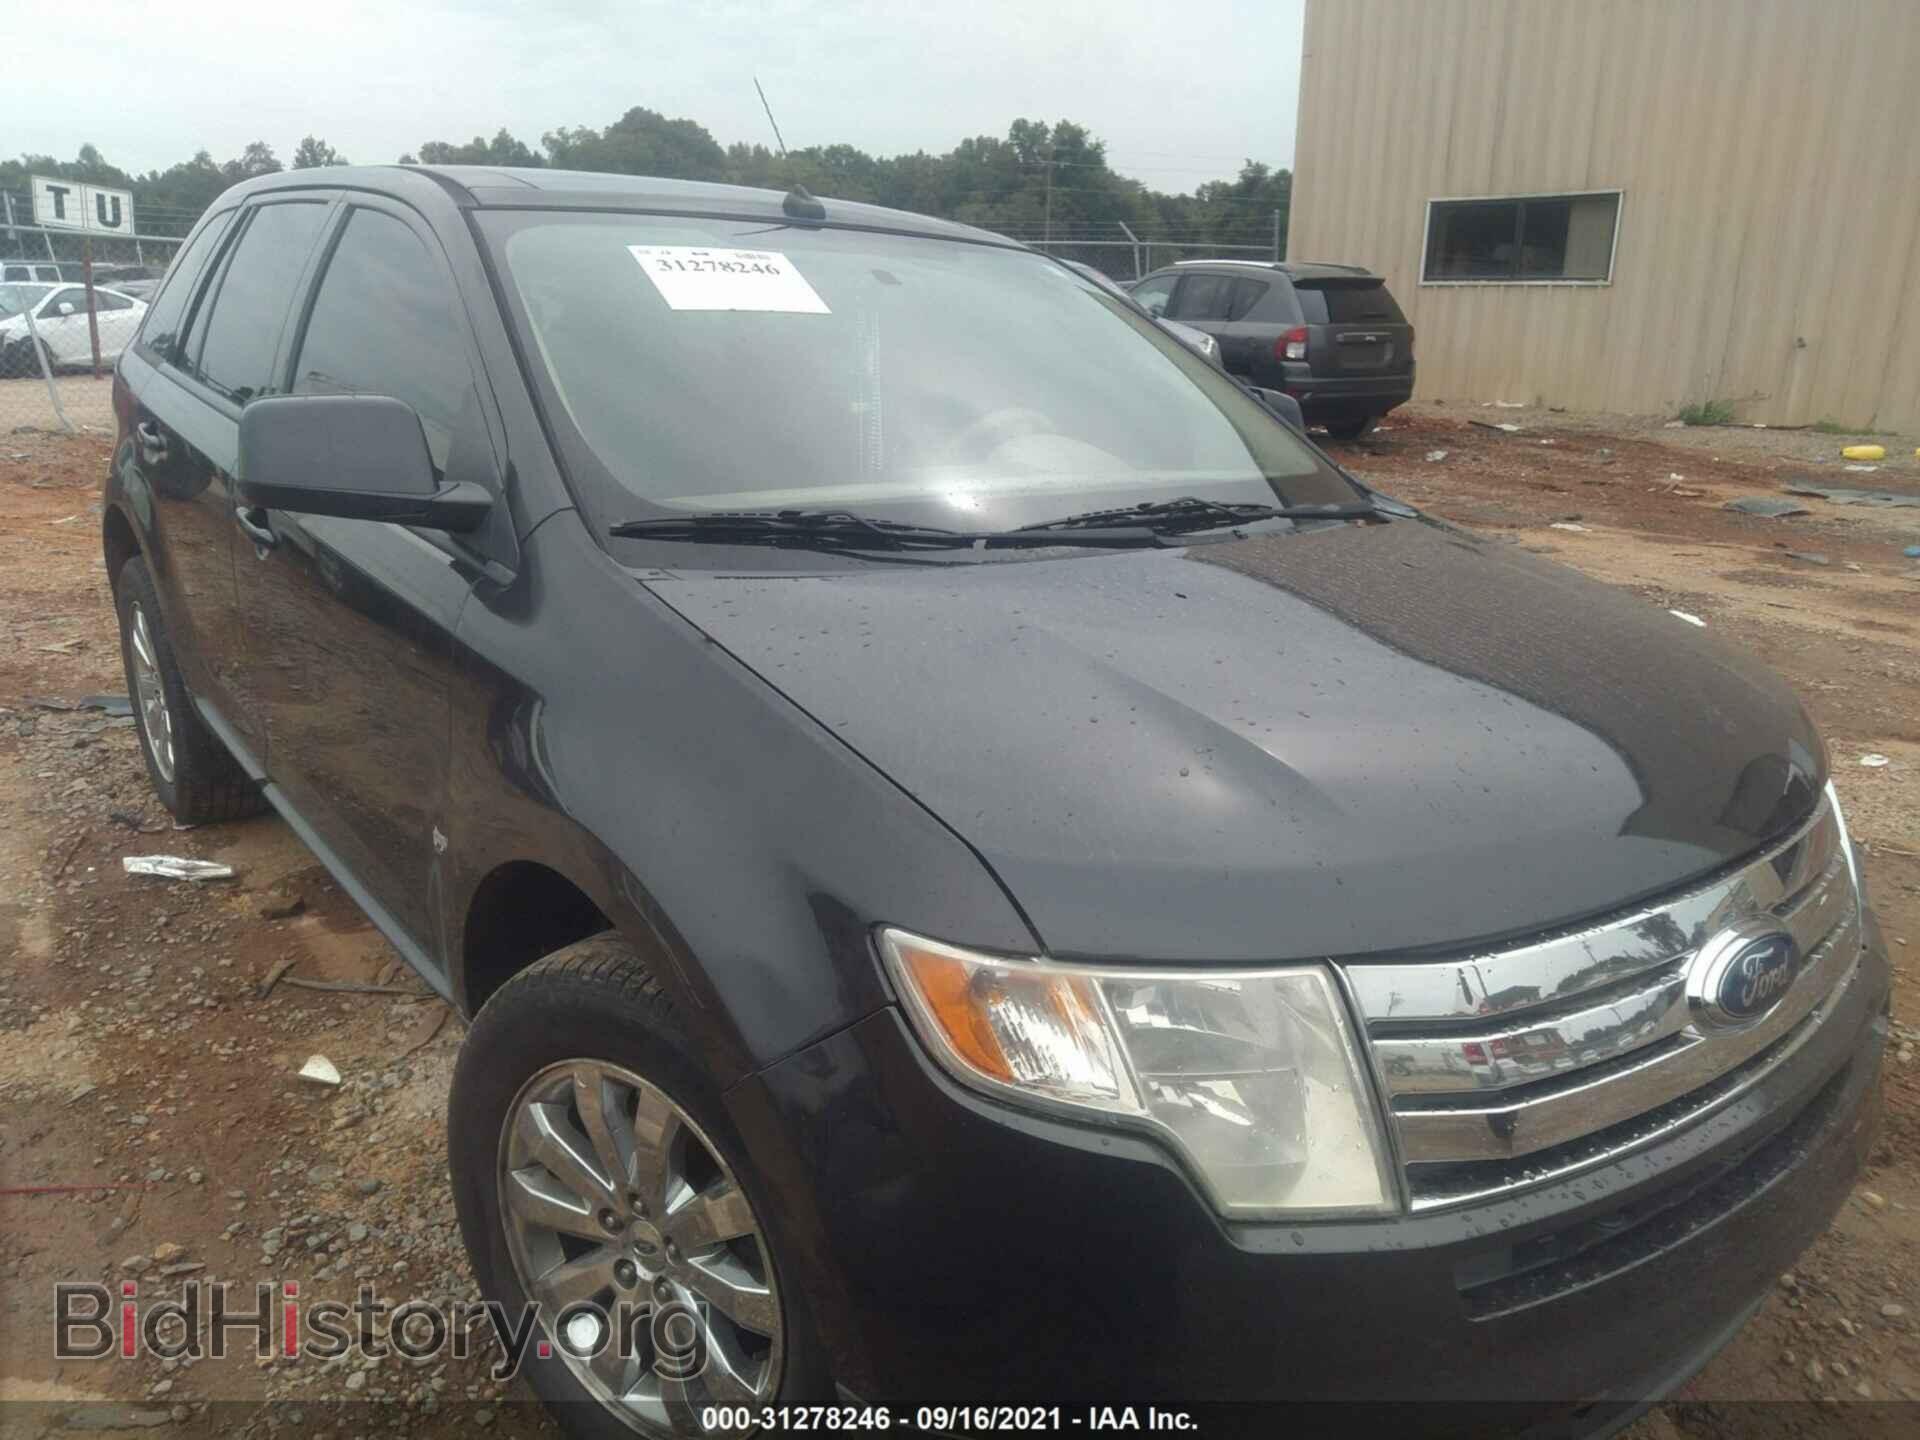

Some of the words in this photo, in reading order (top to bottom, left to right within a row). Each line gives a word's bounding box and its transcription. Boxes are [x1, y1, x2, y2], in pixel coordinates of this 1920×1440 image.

[46, 184, 71, 220] T
[95, 192, 122, 228] U
[656, 258, 781, 276] 31278246
[1741, 946, 1789, 1008] Ford
